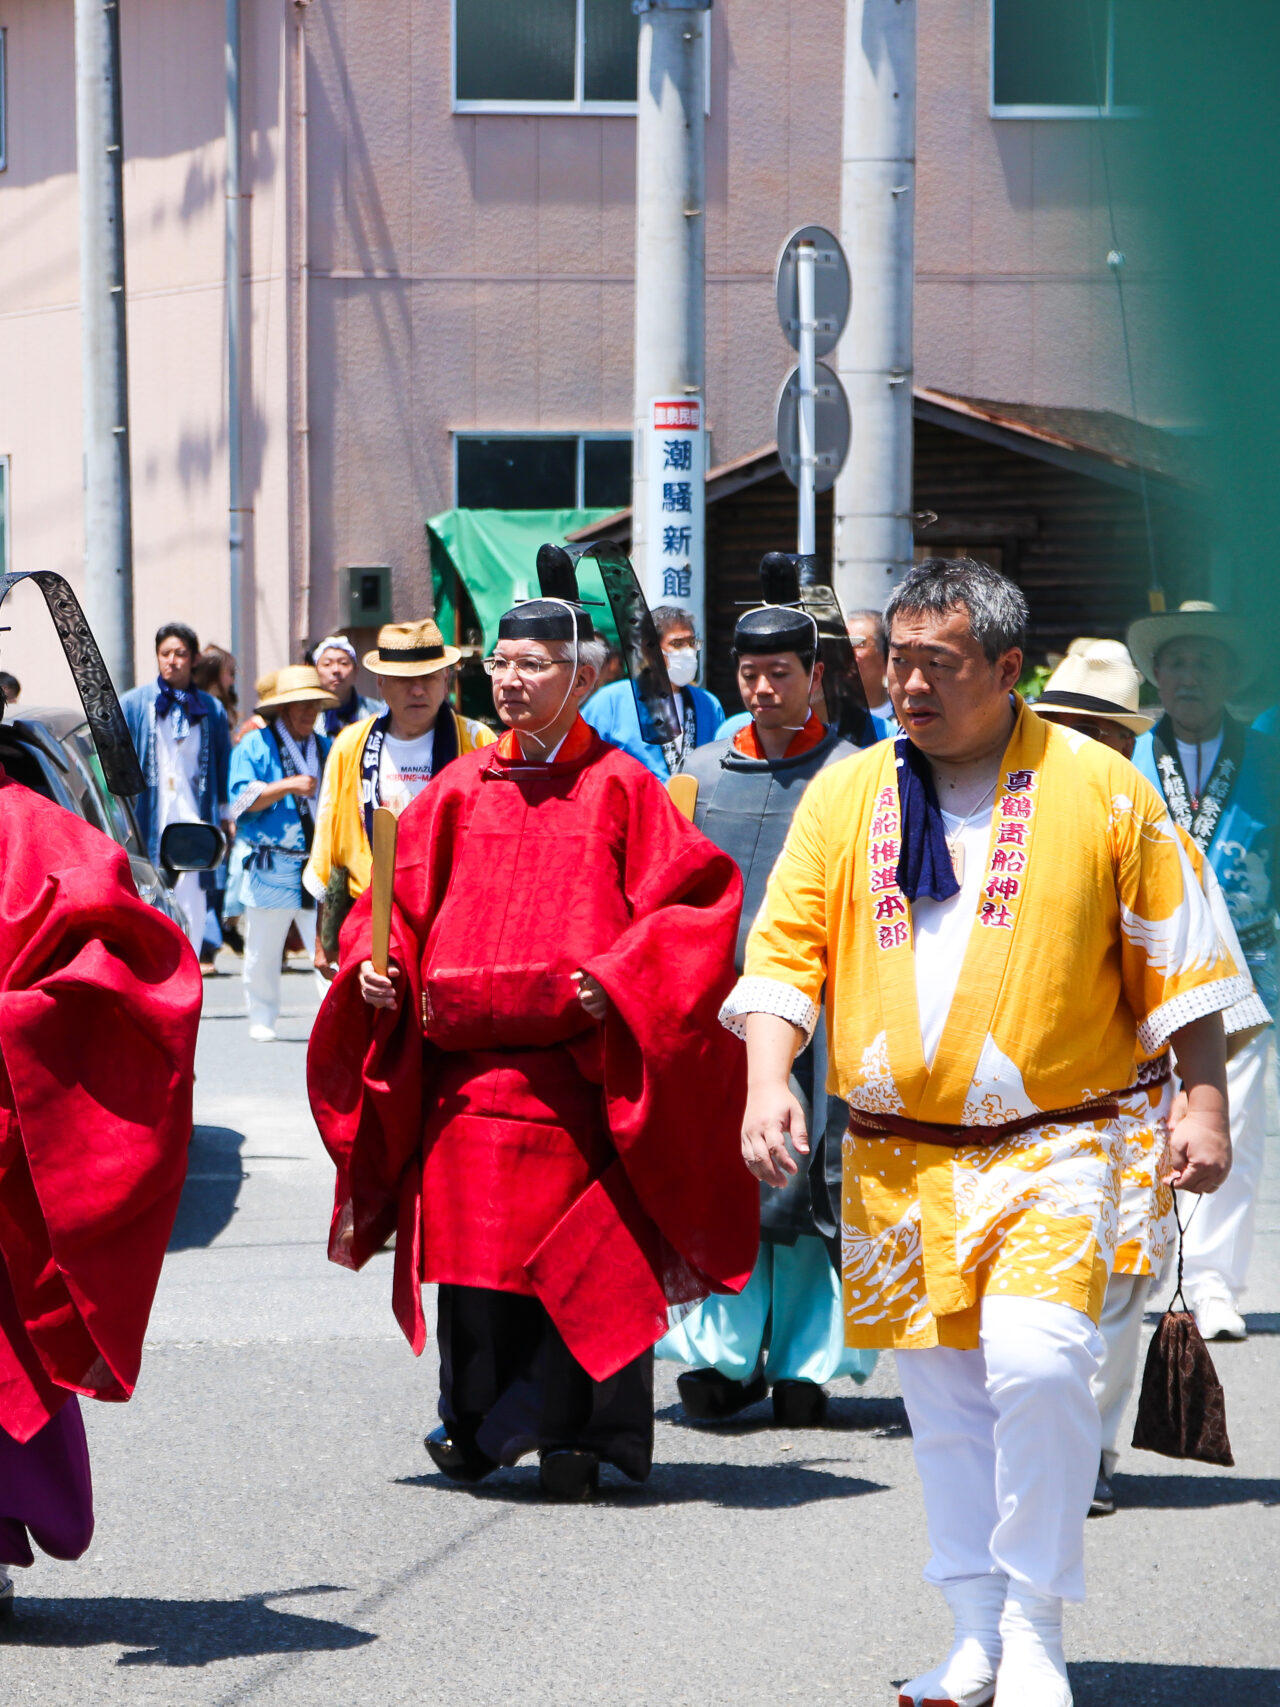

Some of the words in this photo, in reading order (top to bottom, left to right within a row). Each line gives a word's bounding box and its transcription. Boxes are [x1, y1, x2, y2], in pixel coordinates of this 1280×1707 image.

[662, 439, 693, 598] 潮騒新館
[979, 770, 1037, 930] 真鶴貴船神社
